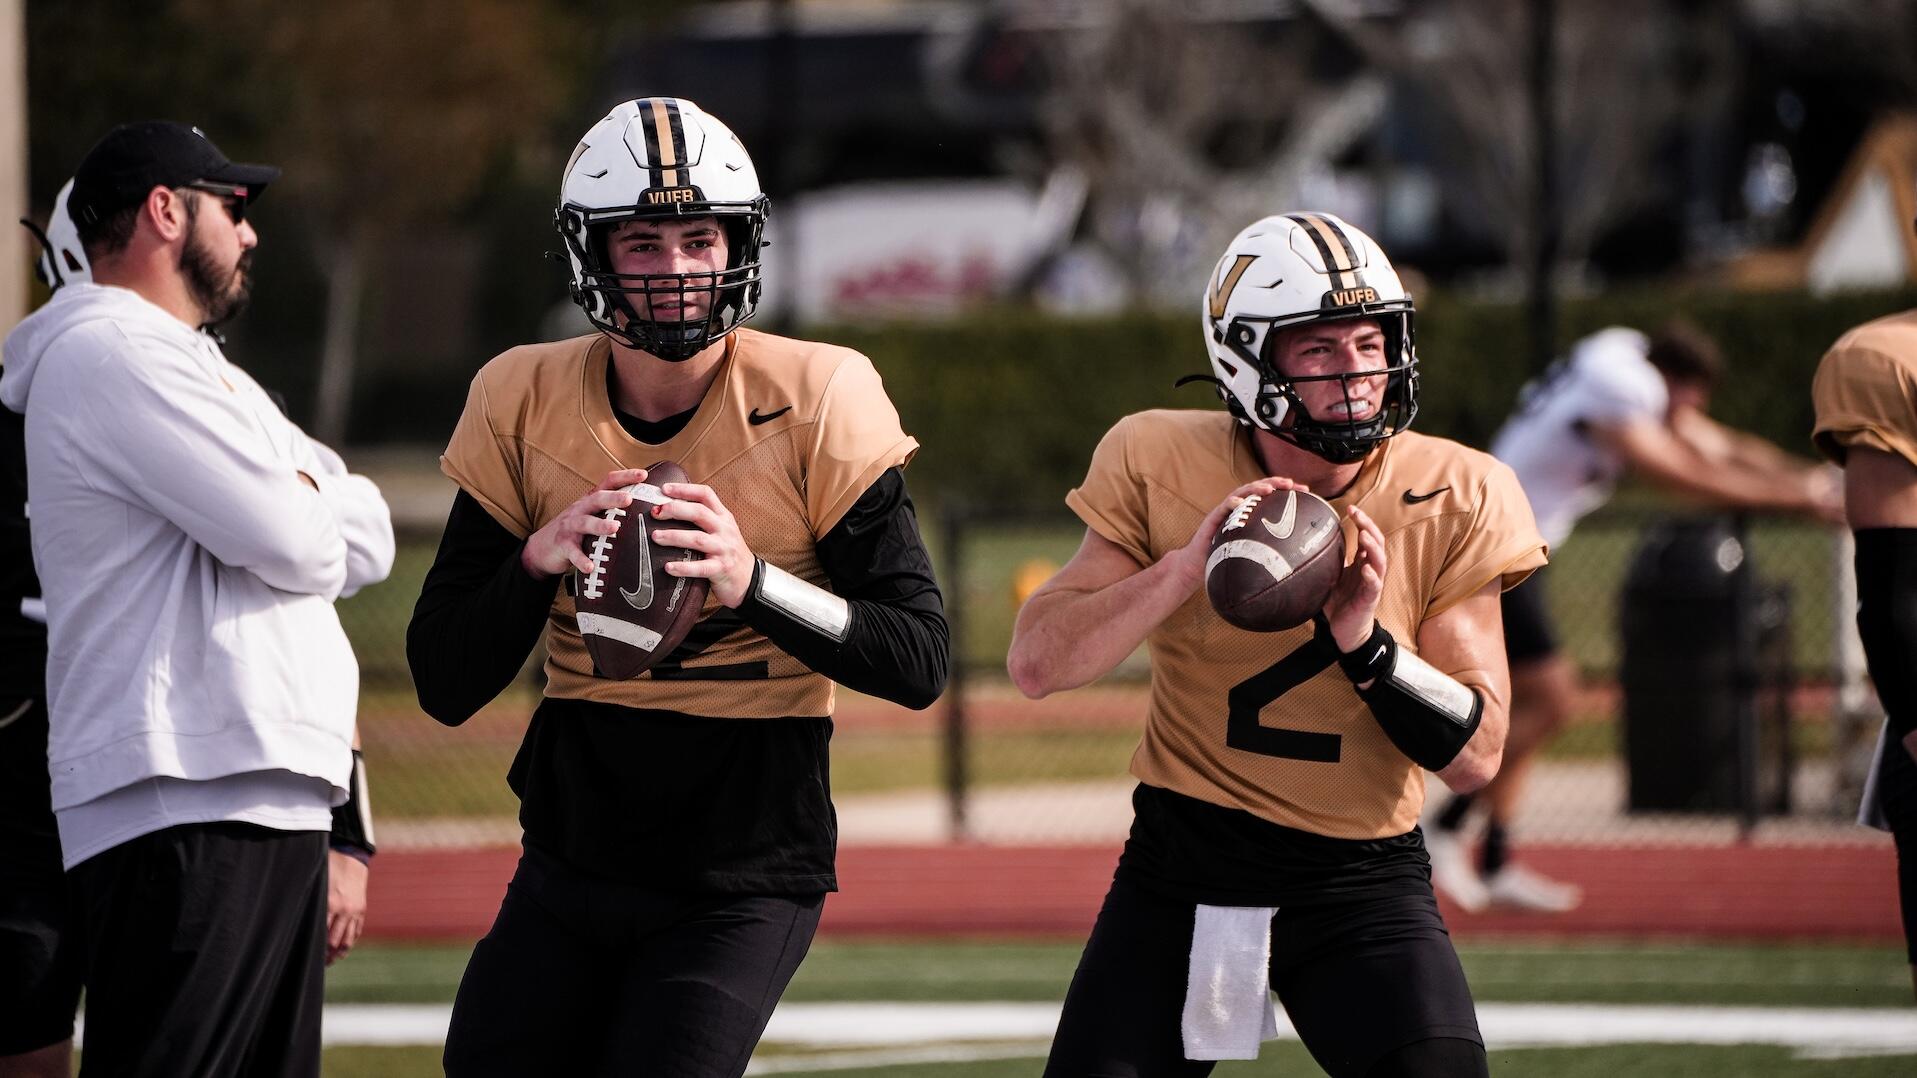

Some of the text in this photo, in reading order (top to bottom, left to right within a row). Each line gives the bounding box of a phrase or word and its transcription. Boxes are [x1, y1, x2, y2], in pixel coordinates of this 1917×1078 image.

[647, 189, 694, 204] VUFB
[1208, 254, 1263, 320] V
[1331, 288, 1376, 306] VUFB
[1225, 610, 1343, 764] 2
